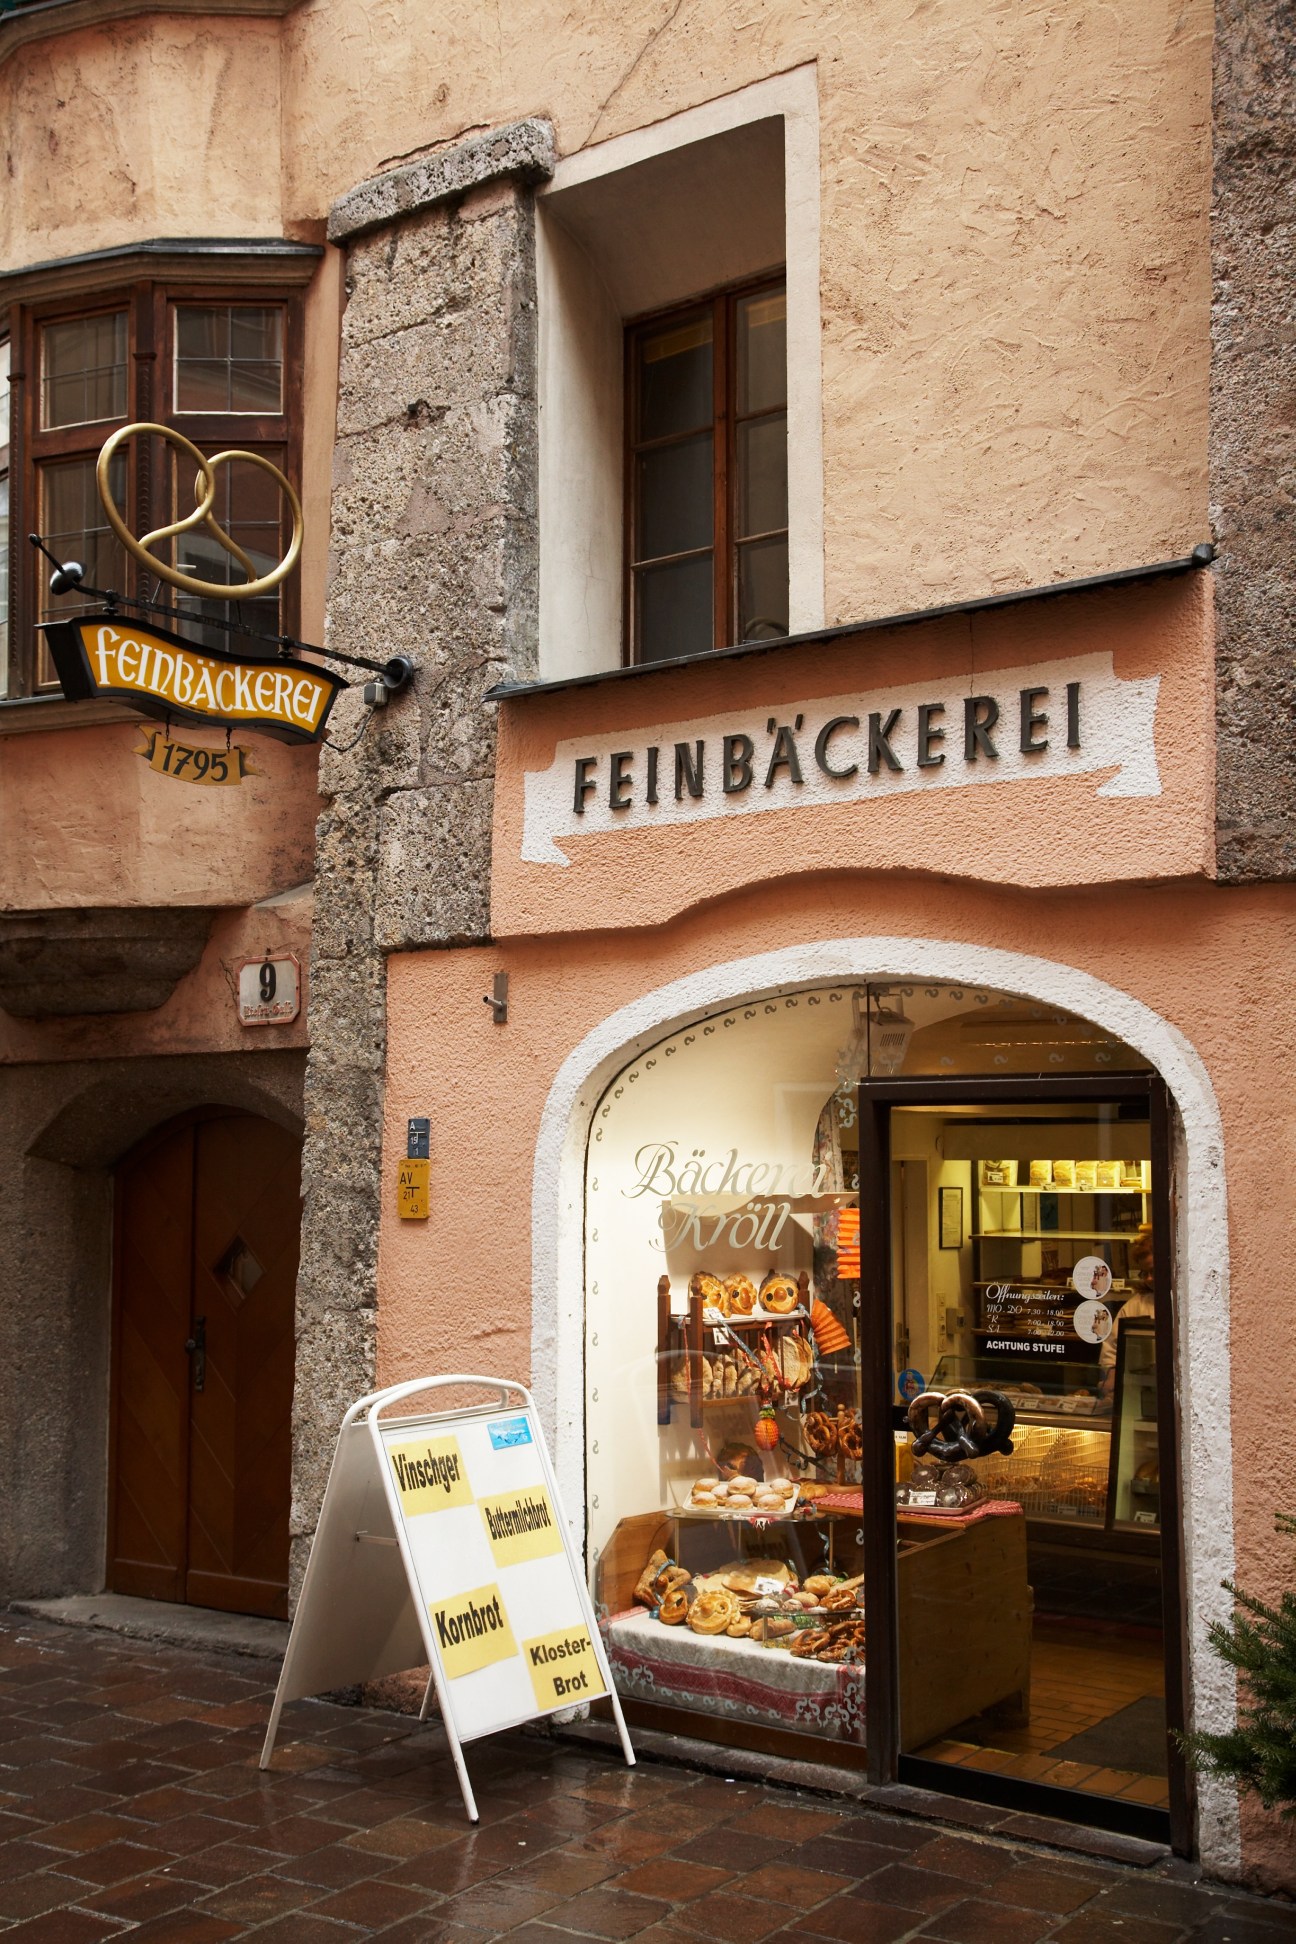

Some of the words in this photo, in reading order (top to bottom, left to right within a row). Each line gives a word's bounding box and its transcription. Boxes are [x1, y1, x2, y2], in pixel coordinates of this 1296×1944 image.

[162, 743, 229, 782] 1795
[572, 681, 1083, 813] FEINBÄCKEREI
[259, 962, 277, 1002] 9
[410, 1121, 416, 1130] A
[400, 1171, 413, 1185] AV
[621, 1140, 832, 1199] Bäckerei
[648, 1202, 791, 1252] Kröll
[986, 1340, 1031, 1351] ACHTUNG
[1032, 1343, 1065, 1353] STUFE!
[391, 1448, 460, 1493] Vinschger
[484, 1495, 552, 1541] Buttermilchbrot
[435, 1595, 504, 1648] Kornbrot
[529, 1635, 592, 1666] Kloster-
[553, 1670, 589, 1697] Brot
